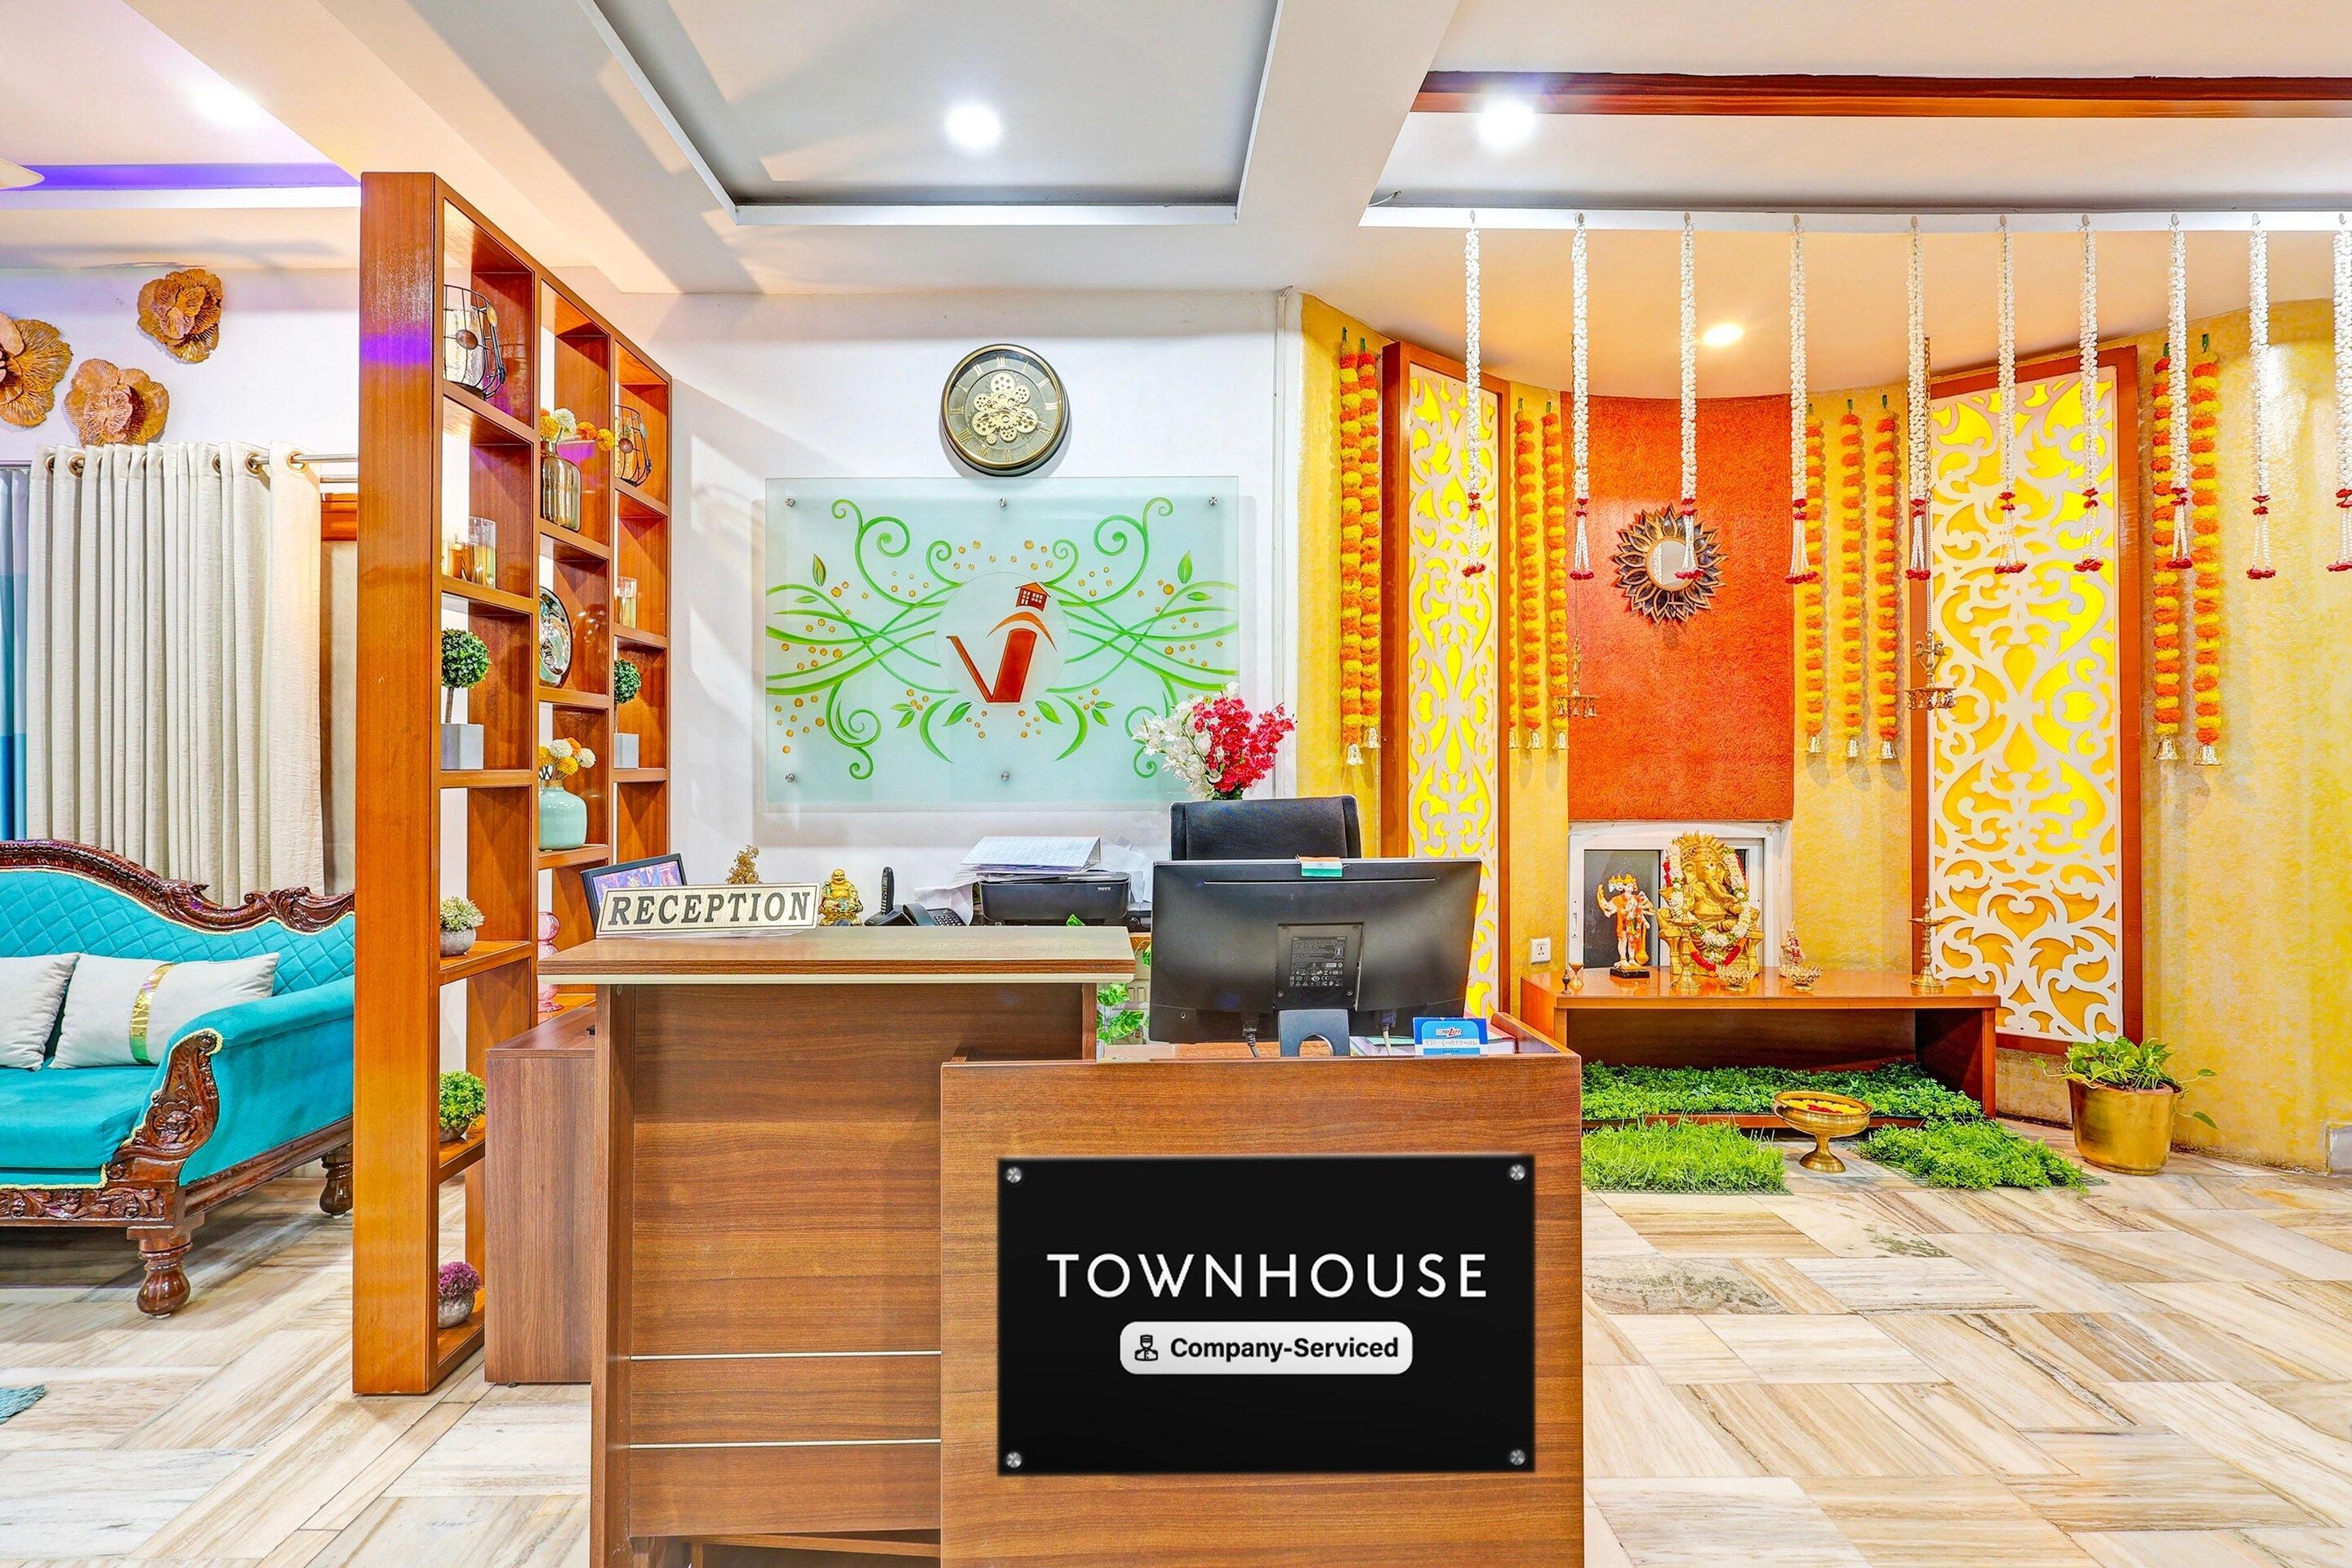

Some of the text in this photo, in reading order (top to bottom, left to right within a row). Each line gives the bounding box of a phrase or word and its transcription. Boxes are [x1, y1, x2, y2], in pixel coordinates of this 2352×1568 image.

[1044, 401, 1058, 411] III
[608, 891, 811, 926] RECEPTION
[1046, 1253, 1487, 1298] TOWNHOUSE
[1169, 1337, 1399, 1362] Company-Serviced
